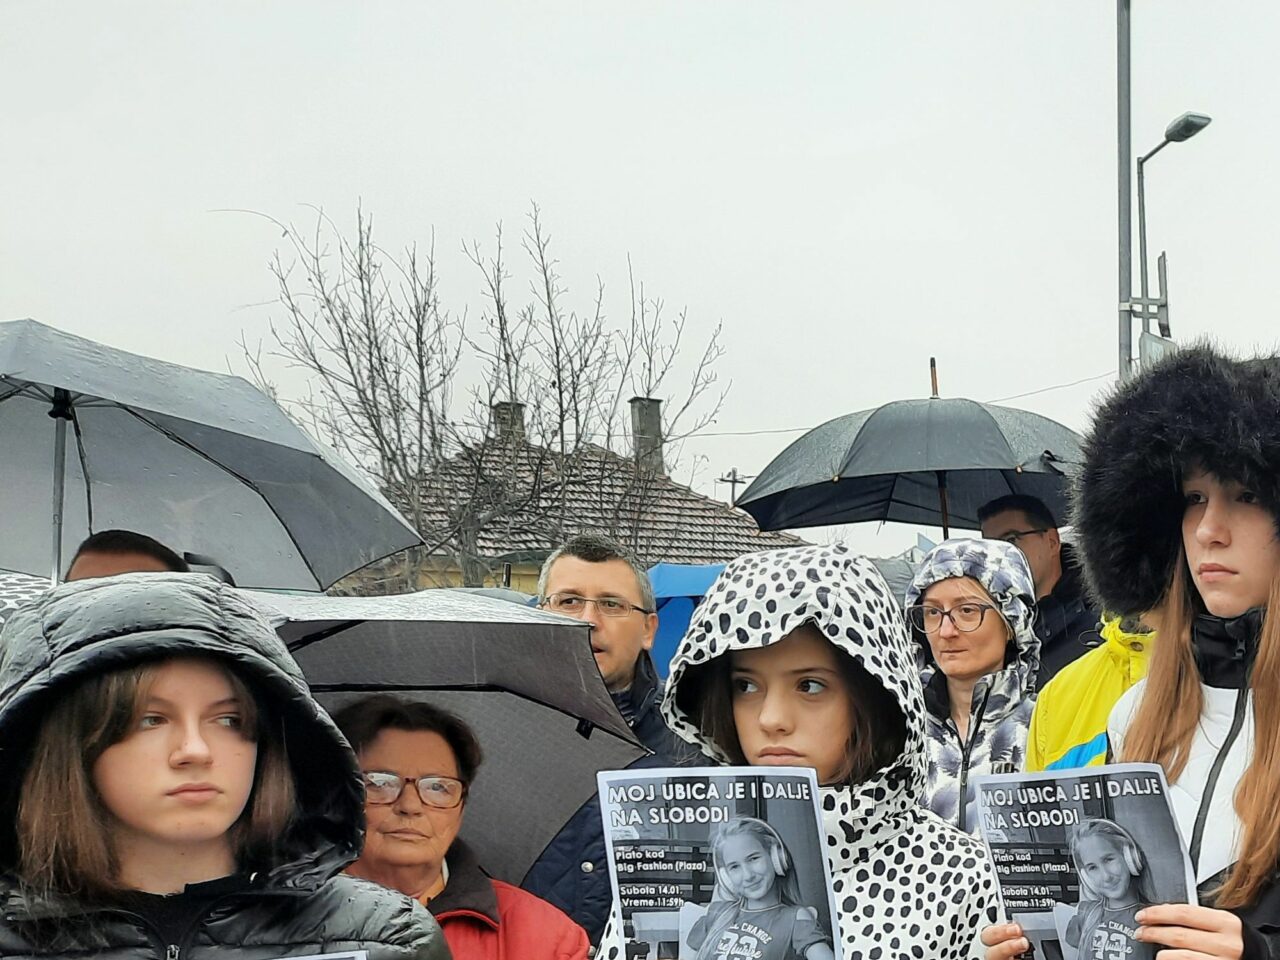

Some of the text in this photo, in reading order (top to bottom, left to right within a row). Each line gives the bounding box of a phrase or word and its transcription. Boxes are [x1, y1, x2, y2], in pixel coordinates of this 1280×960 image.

[608, 782, 811, 804] MOJ UBICA JE I DALJE
[981, 778, 1161, 808] MOJ UBICA JE I DALJE
[611, 806, 730, 827] NA SLOBODI
[984, 808, 1080, 830] NA SLOBODI
[615, 849, 665, 861] Plato kod
[994, 853, 1031, 863] Plato kod
[617, 860, 707, 874] Big Fashion (Plaza)
[1011, 864, 1040, 874] Fashion
[1041, 863, 1070, 874] (Plaza)
[620, 885, 683, 896] Subota 14.01.
[1002, 887, 1028, 897] Subota
[621, 897, 685, 908] Vreme 11:59h
